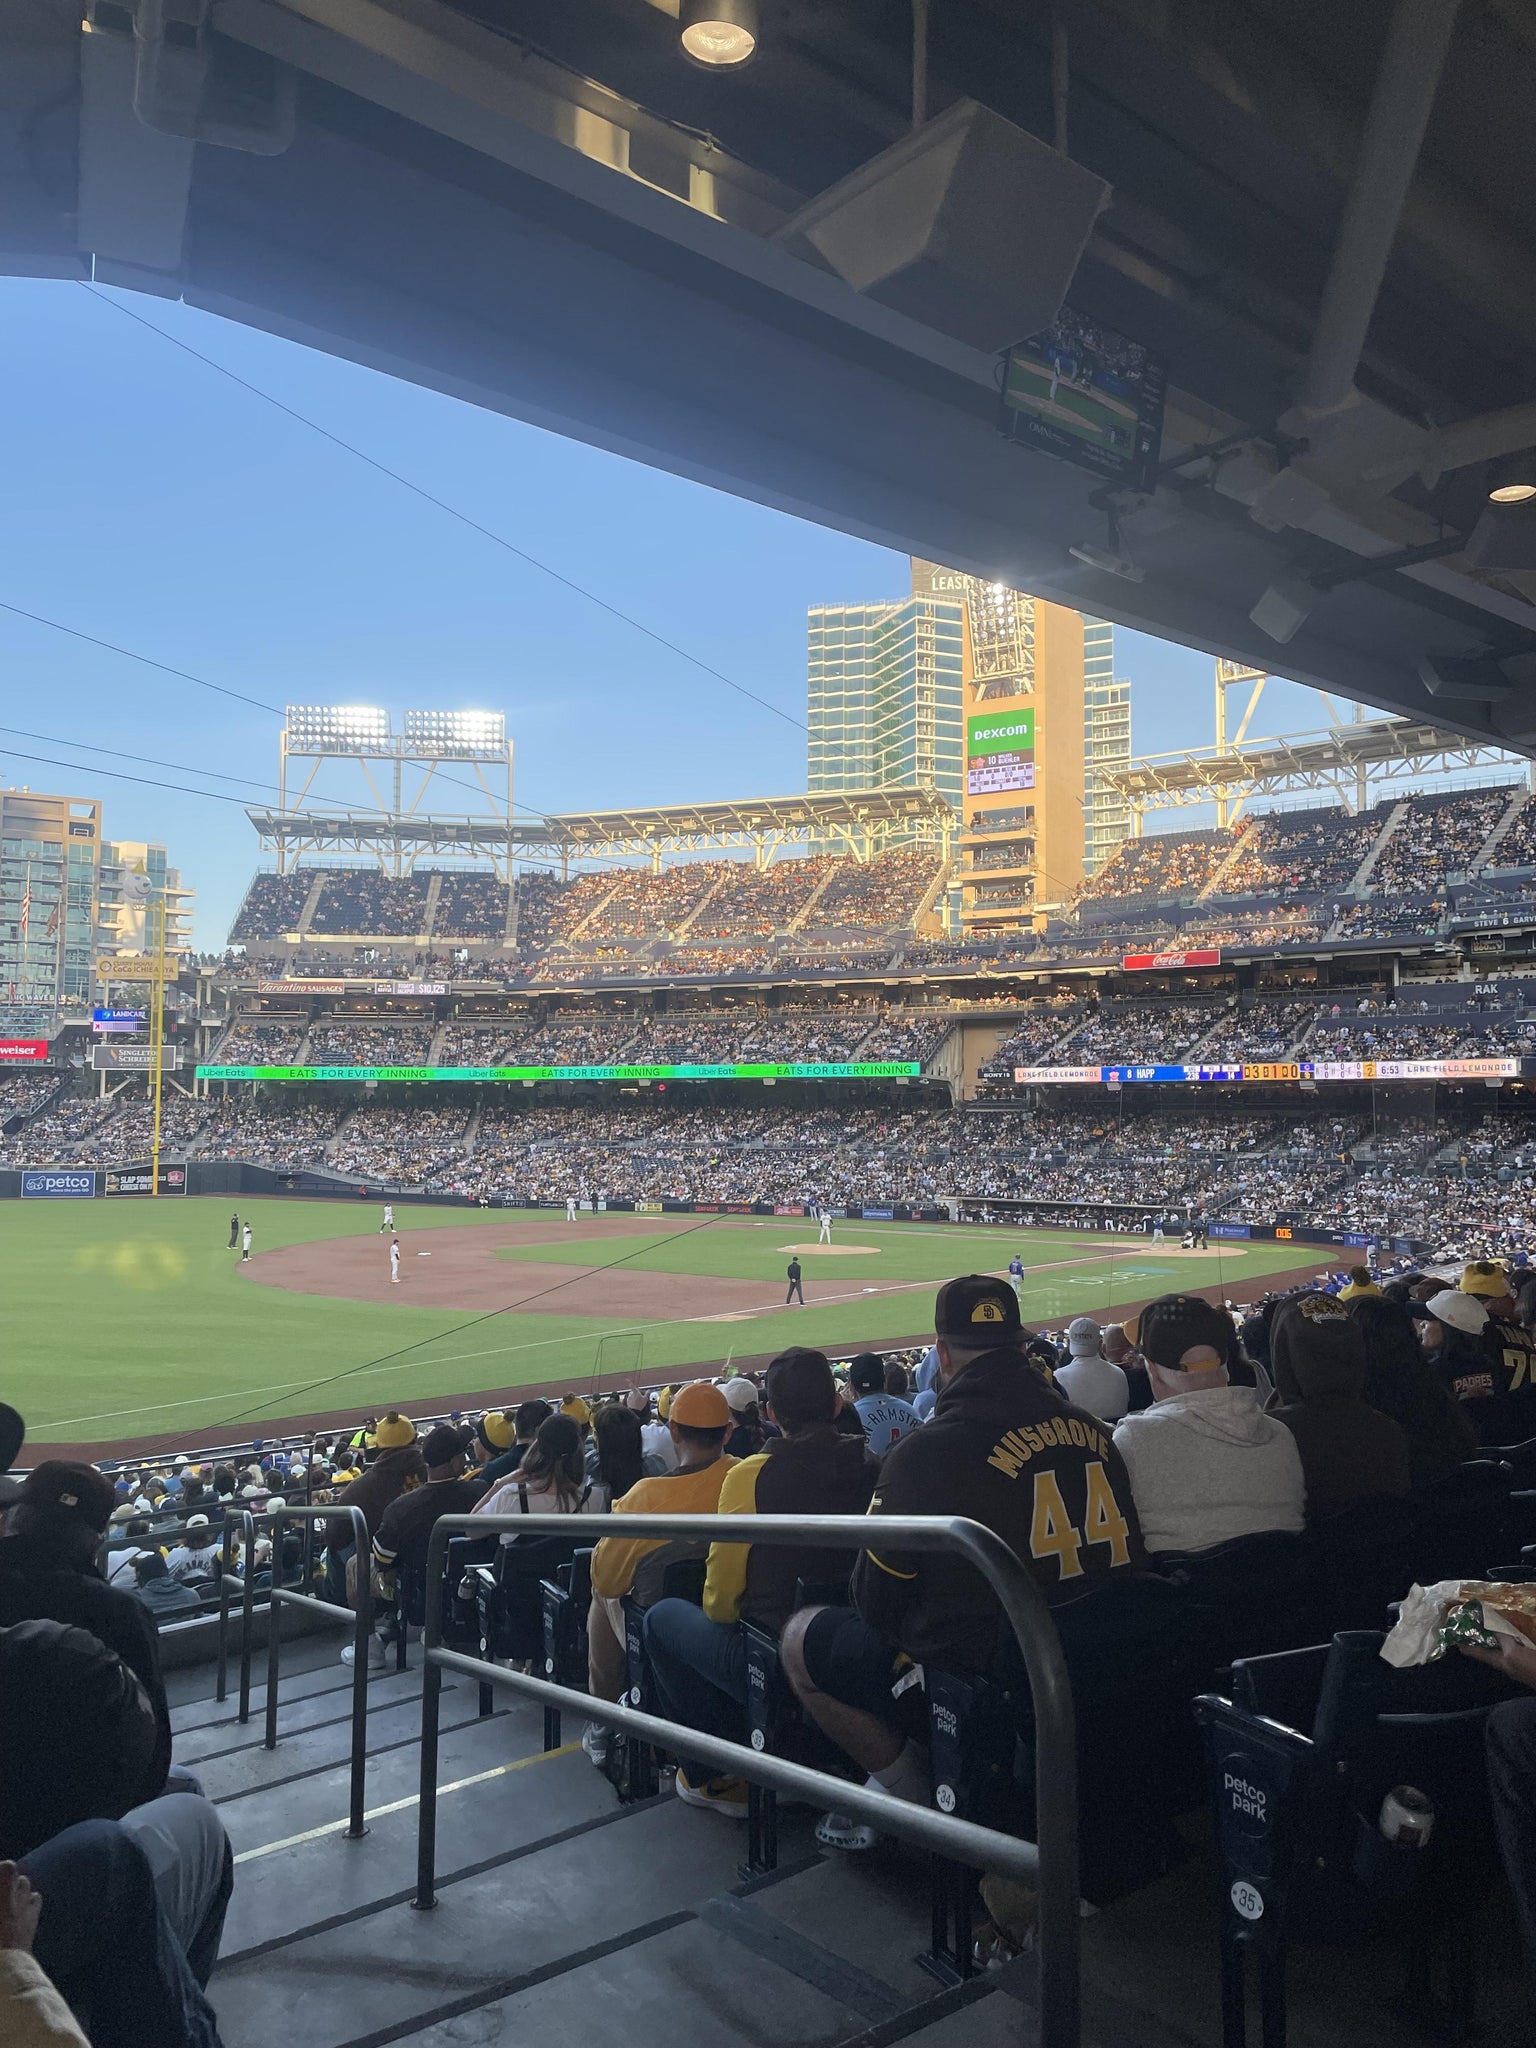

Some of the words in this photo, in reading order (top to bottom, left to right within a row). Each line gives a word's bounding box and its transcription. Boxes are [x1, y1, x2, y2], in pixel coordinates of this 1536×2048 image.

[931, 576, 969, 591] LEASI
[1474, 919, 1499, 928] STEVE
[1502, 917, 1509, 926] 6
[260, 982, 307, 992] Tarantino
[307, 984, 343, 993] SAUSAGES
[1475, 984, 1498, 994] RAK
[118, 1048, 158, 1056] SINGLETO
[118, 1055, 158, 1063] SCHREIBE
[225, 1068, 246, 1076] Eats
[289, 1069, 318, 1077] EATS
[321, 1069, 344, 1077] FOR
[347, 1069, 383, 1077] EVERY
[386, 1069, 427, 1077] INNING
[541, 1069, 565, 1077] EATS
[568, 1068, 587, 1077] FOR
[590, 1068, 621, 1077] EVERY
[624, 1068, 660, 1076] INNING
[776, 1066, 803, 1075] EATS
[806, 1066, 828, 1075] FOR
[832, 1066, 867, 1074] EVERY
[870, 1065, 912, 1074] INNING
[1126, 1069, 1133, 1079] 8
[1136, 1068, 1155, 1079] HAPP
[1253, 1065, 1260, 1079] 3
[1381, 1065, 1400, 1075] 6:53
[46, 1176, 90, 1190] petco
[120, 1176, 136, 1184] SLAP
[1455, 1374, 1493, 1392] PADRES
[987, 1415, 1109, 1480] MUSGROVE
[1029, 1461, 1131, 1581] 44
[748, 1664, 765, 1680] petco
[751, 1675, 765, 1691] park
[933, 1702, 957, 1725] petco
[937, 1716, 957, 1737] park
[1224, 1772, 1267, 1805] petco
[940, 1789, 951, 1807] 34
[1232, 1792, 1267, 1822] park
[1239, 1887, 1256, 1913] 35
